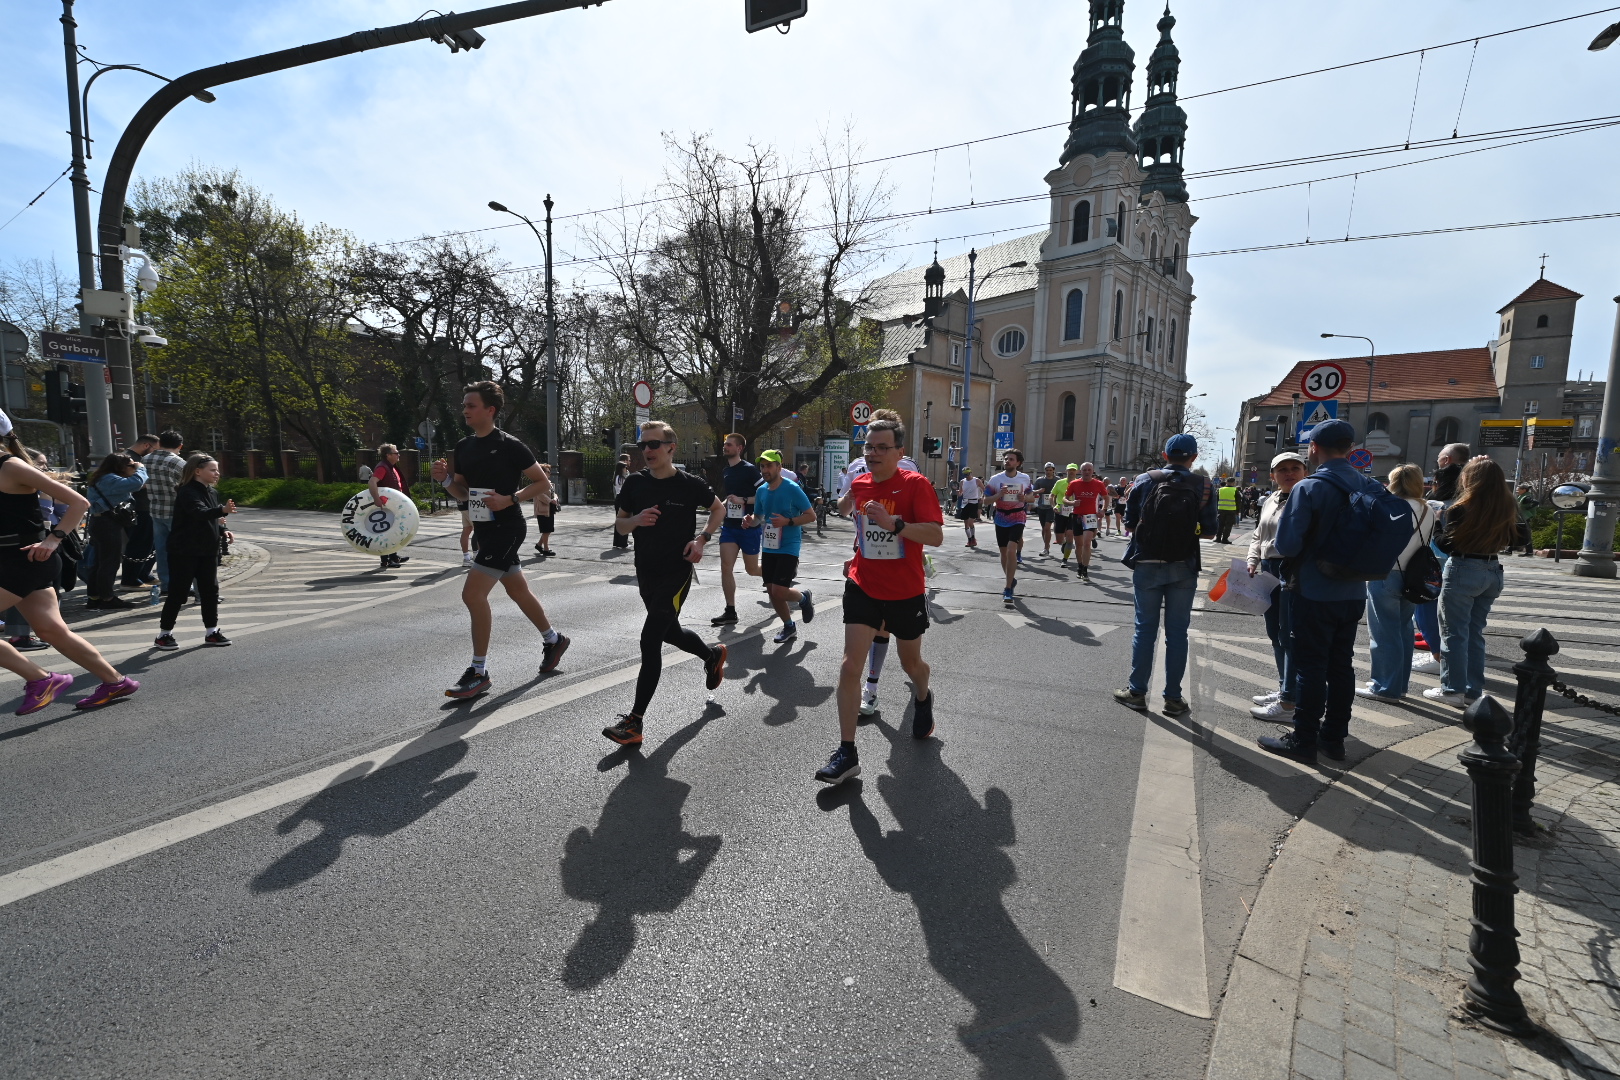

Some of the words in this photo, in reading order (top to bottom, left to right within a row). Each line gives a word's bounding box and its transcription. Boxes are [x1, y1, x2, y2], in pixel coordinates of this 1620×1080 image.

[48, 341, 100, 356] Garbary
[1307, 371, 1340, 391] 30
[854, 406, 870, 419] 30
[1000, 414, 1009, 424] P
[342, 495, 363, 524] ALEX
[368, 510, 391, 533] GO
[346, 528, 373, 549] MARI
[865, 530, 894, 543] 9092
